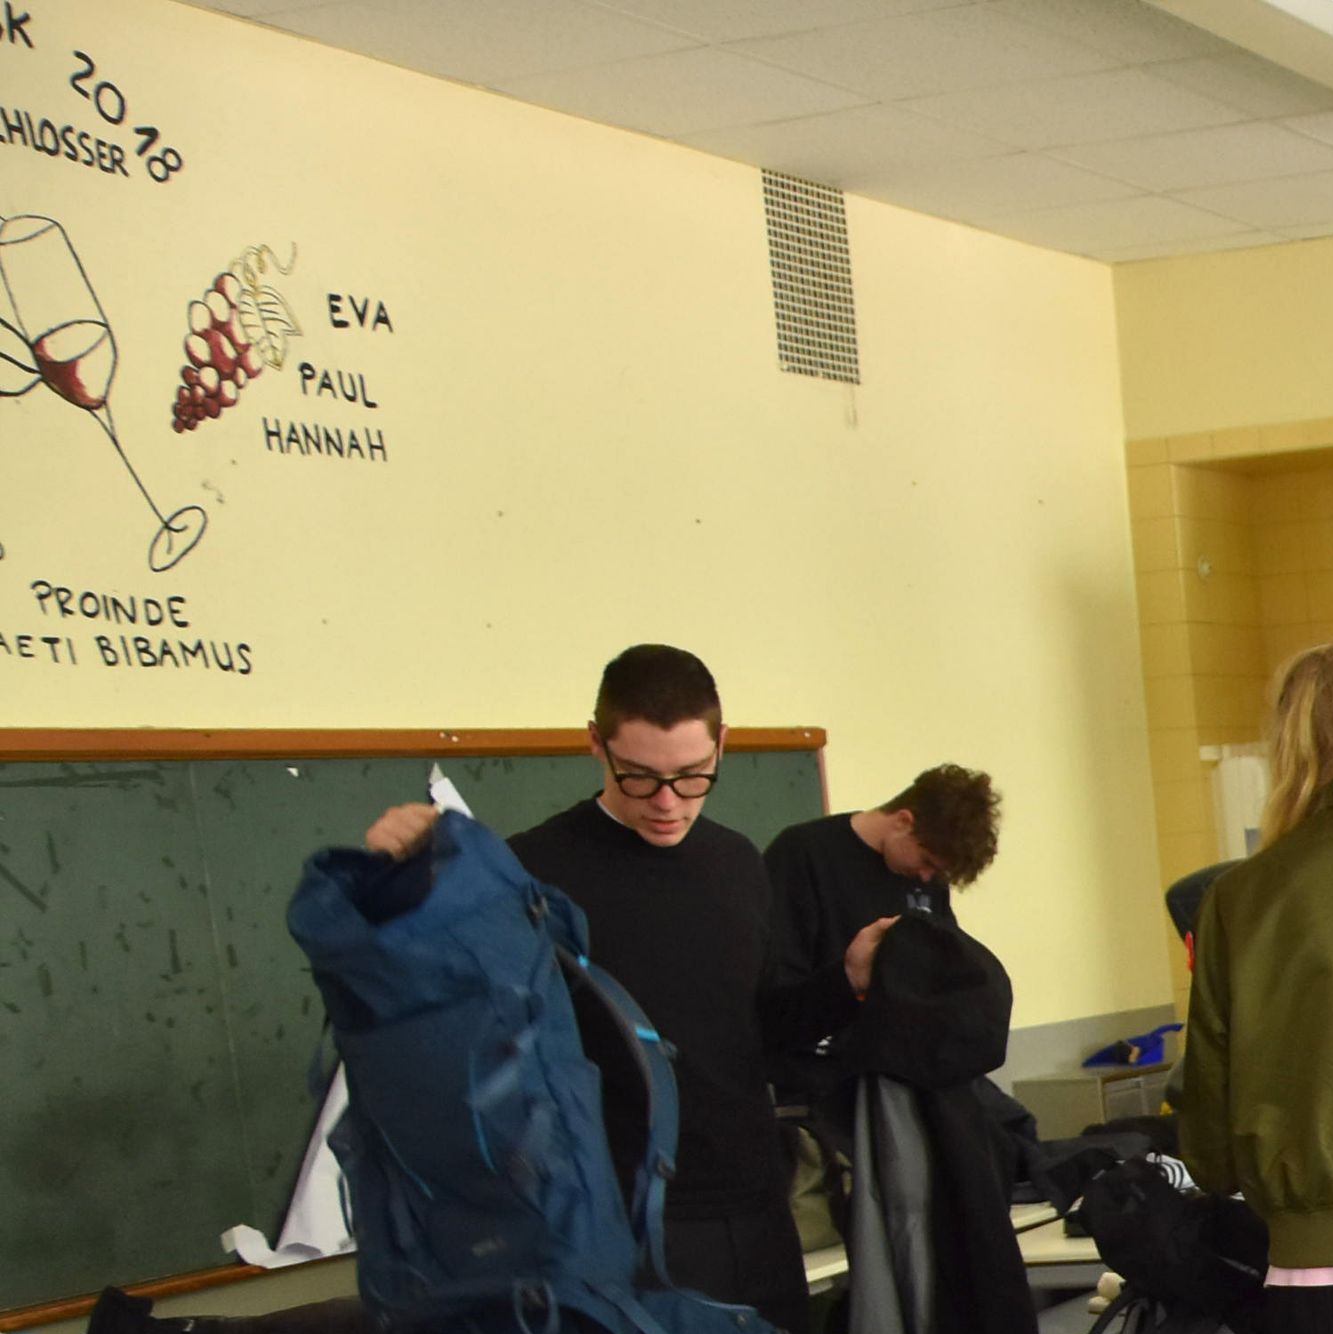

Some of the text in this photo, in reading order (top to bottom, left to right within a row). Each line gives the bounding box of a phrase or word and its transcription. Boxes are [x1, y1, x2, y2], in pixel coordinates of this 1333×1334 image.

[69, 50, 183, 183] 2018
[328, 293, 393, 333] EVA
[299, 362, 378, 408] PAUL
[263, 417, 388, 462] HANNAH
[31, 580, 190, 628] PROINDE
[98, 634, 253, 674] BIBAMUS
